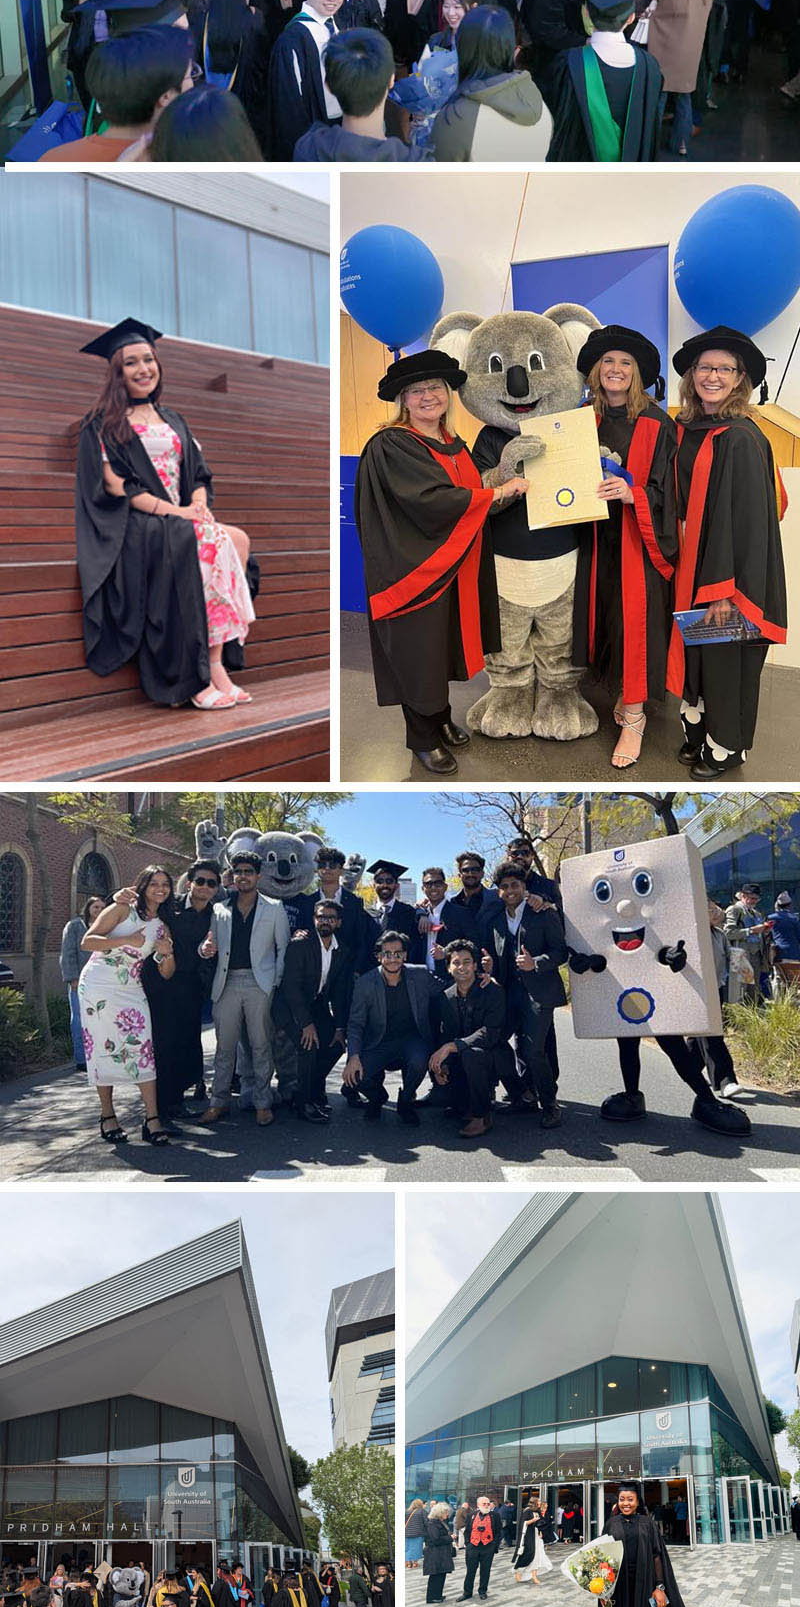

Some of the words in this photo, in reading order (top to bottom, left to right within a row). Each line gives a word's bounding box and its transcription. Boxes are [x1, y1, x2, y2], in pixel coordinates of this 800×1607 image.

[523, 1468, 584, 1479] PRIDHAM
[597, 1465, 635, 1474] HALL
[167, 1491, 198, 1499] University
[7, 1523, 91, 1532] PRIDHAM
[107, 1521, 152, 1531] HALL
